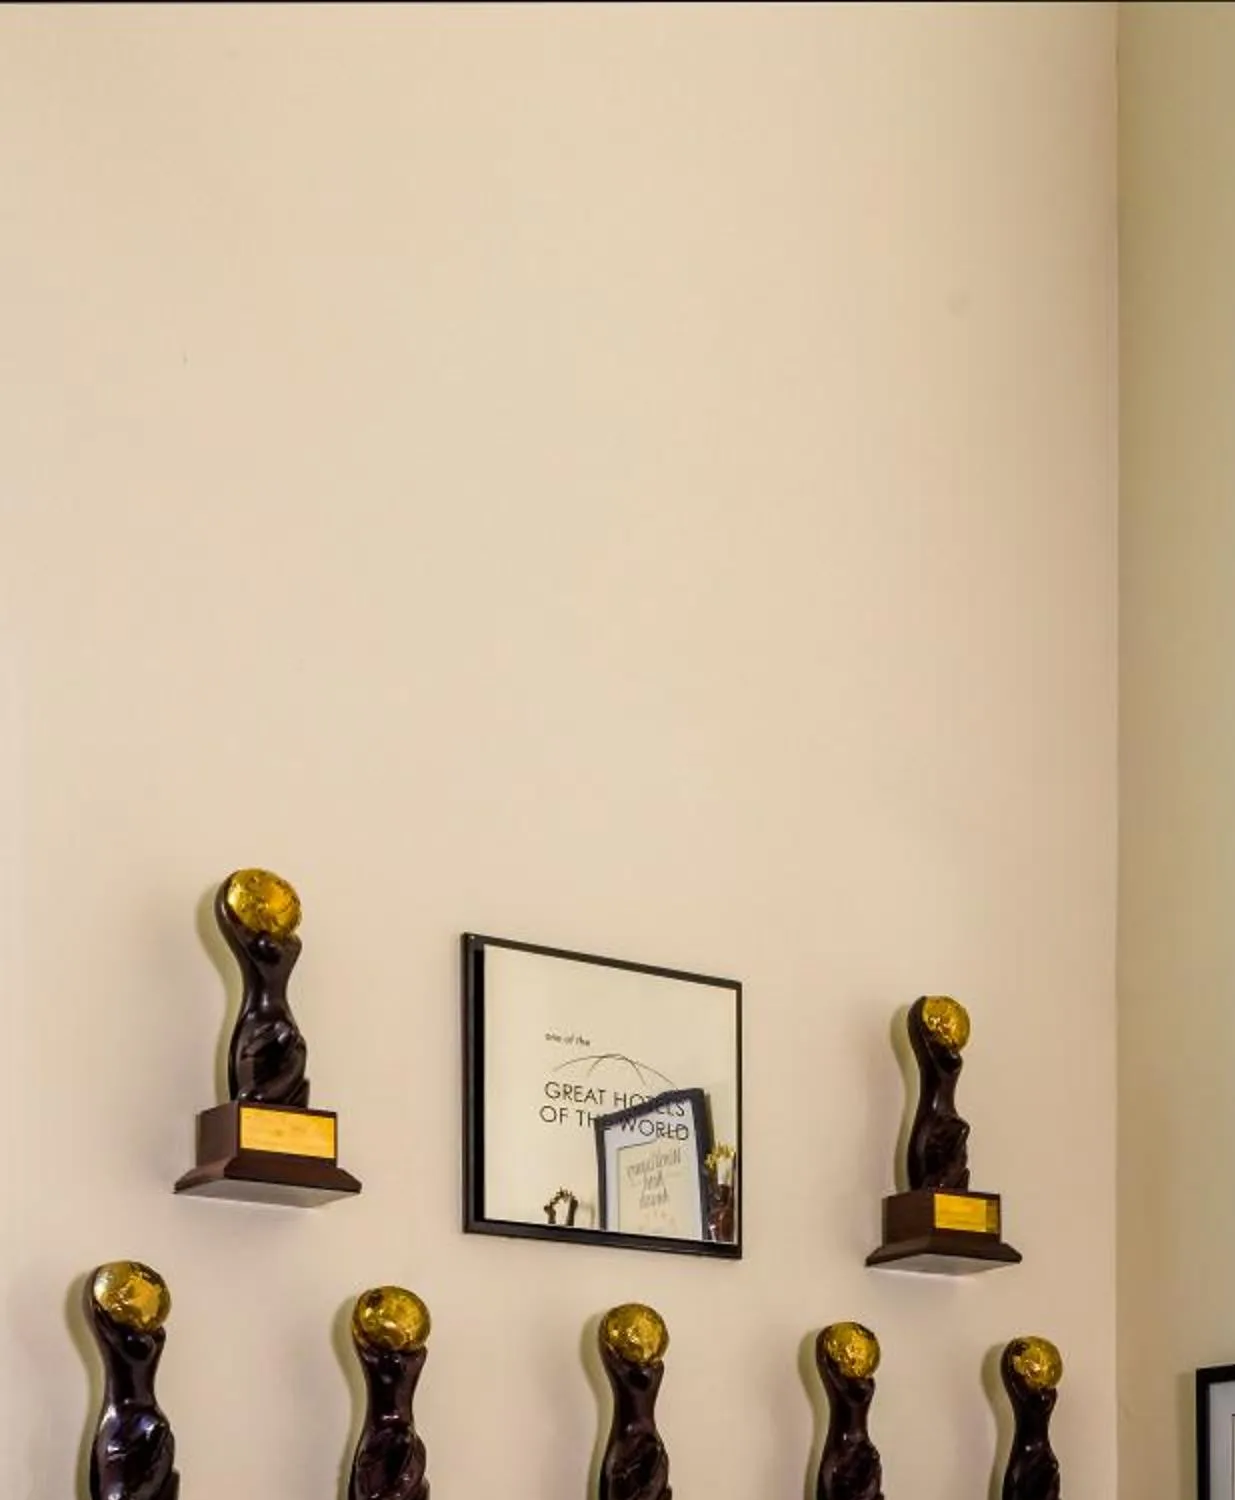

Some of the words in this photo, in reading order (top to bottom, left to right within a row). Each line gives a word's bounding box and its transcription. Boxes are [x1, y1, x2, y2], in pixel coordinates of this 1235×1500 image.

[544, 1081, 606, 1106] GREAT
[613, 1091, 685, 1117] HOELS
[539, 1105, 569, 1125] OF
[620, 1116, 690, 1140] WORLD
